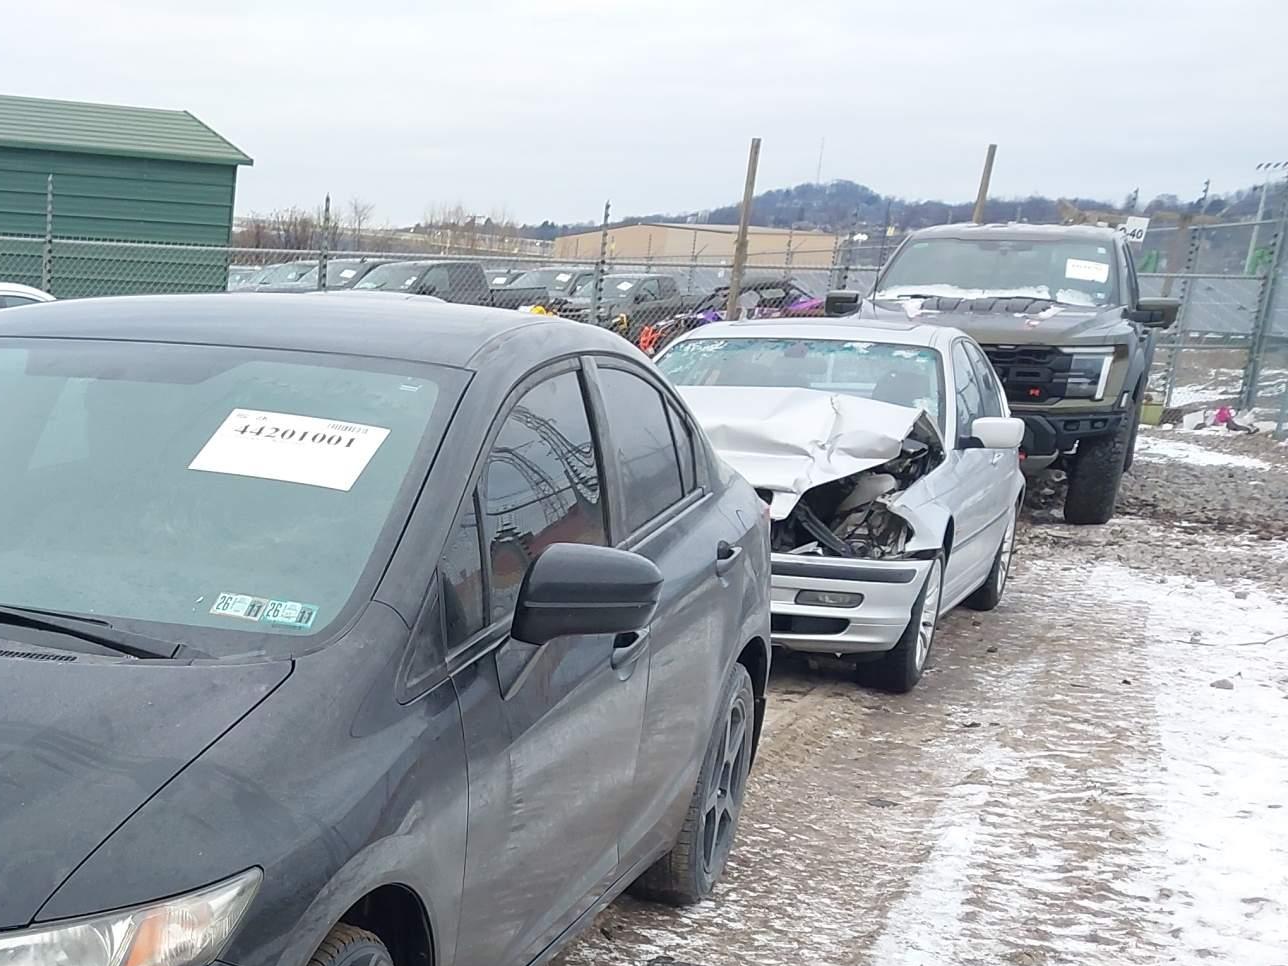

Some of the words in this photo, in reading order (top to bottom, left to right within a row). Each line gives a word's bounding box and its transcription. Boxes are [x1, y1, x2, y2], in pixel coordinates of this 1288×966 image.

[234, 424, 356, 447] 44201001
[216, 596, 233, 611] 26
[266, 603, 282, 618] 26
